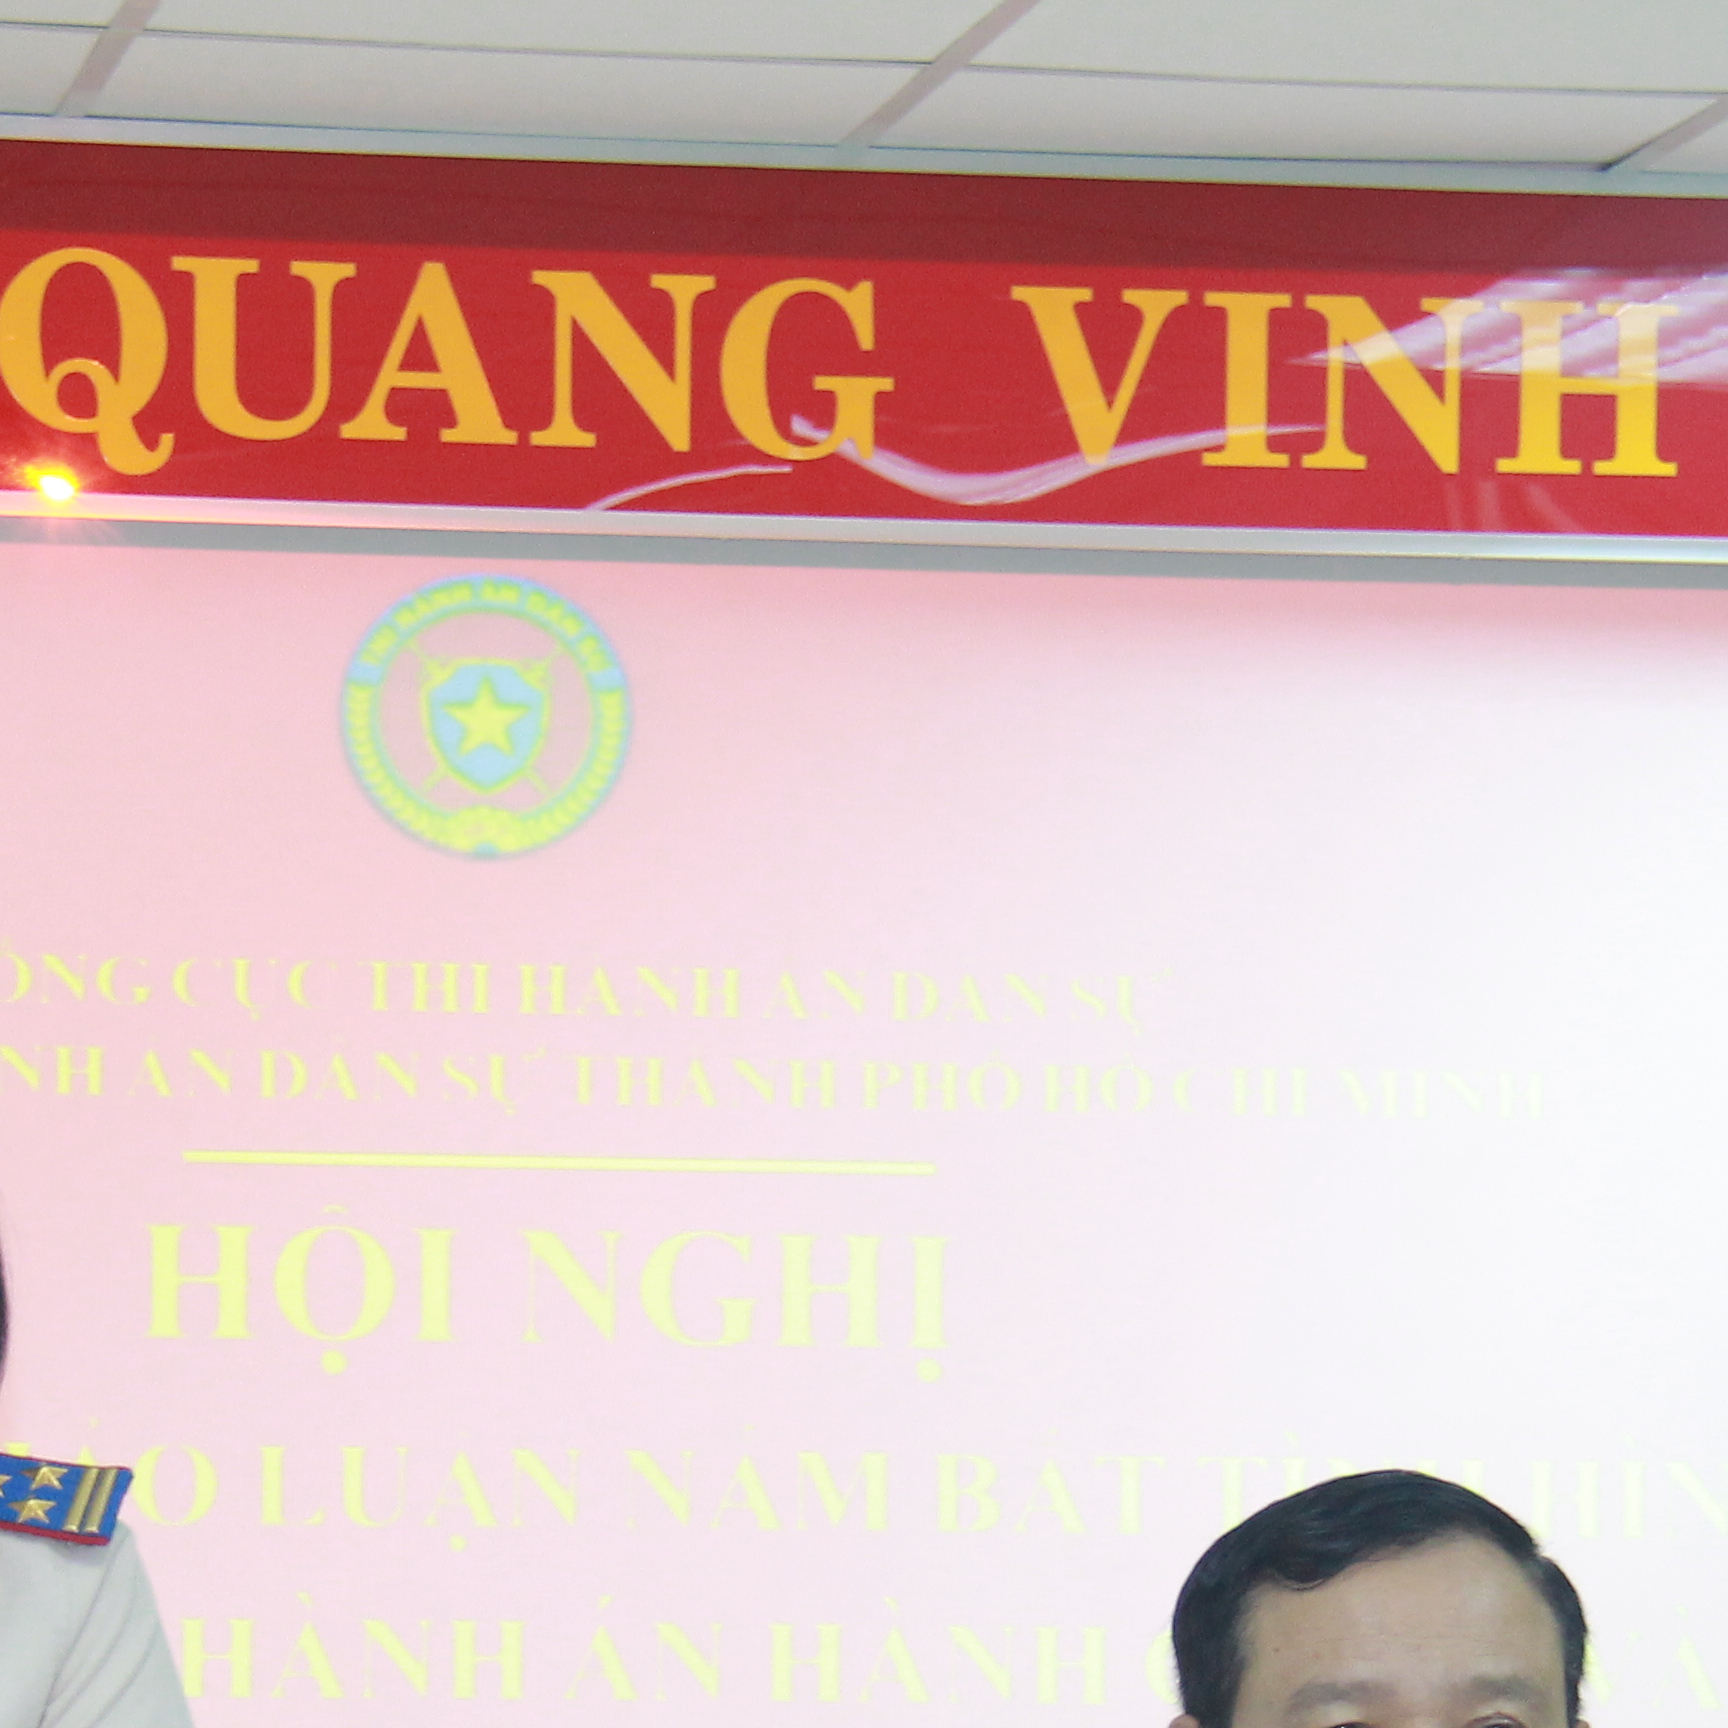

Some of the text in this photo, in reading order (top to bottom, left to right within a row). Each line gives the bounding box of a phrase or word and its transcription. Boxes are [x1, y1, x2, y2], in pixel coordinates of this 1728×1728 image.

[1011, 285, 1680, 478] VINH
[143, 1203, 952, 1384] HỘI NGHỊ
[180, 1590, 528, 1703] HÀNH
[563, 1593, 726, 1703] ÁN
[768, 1596, 1109, 1706] HÀNH
